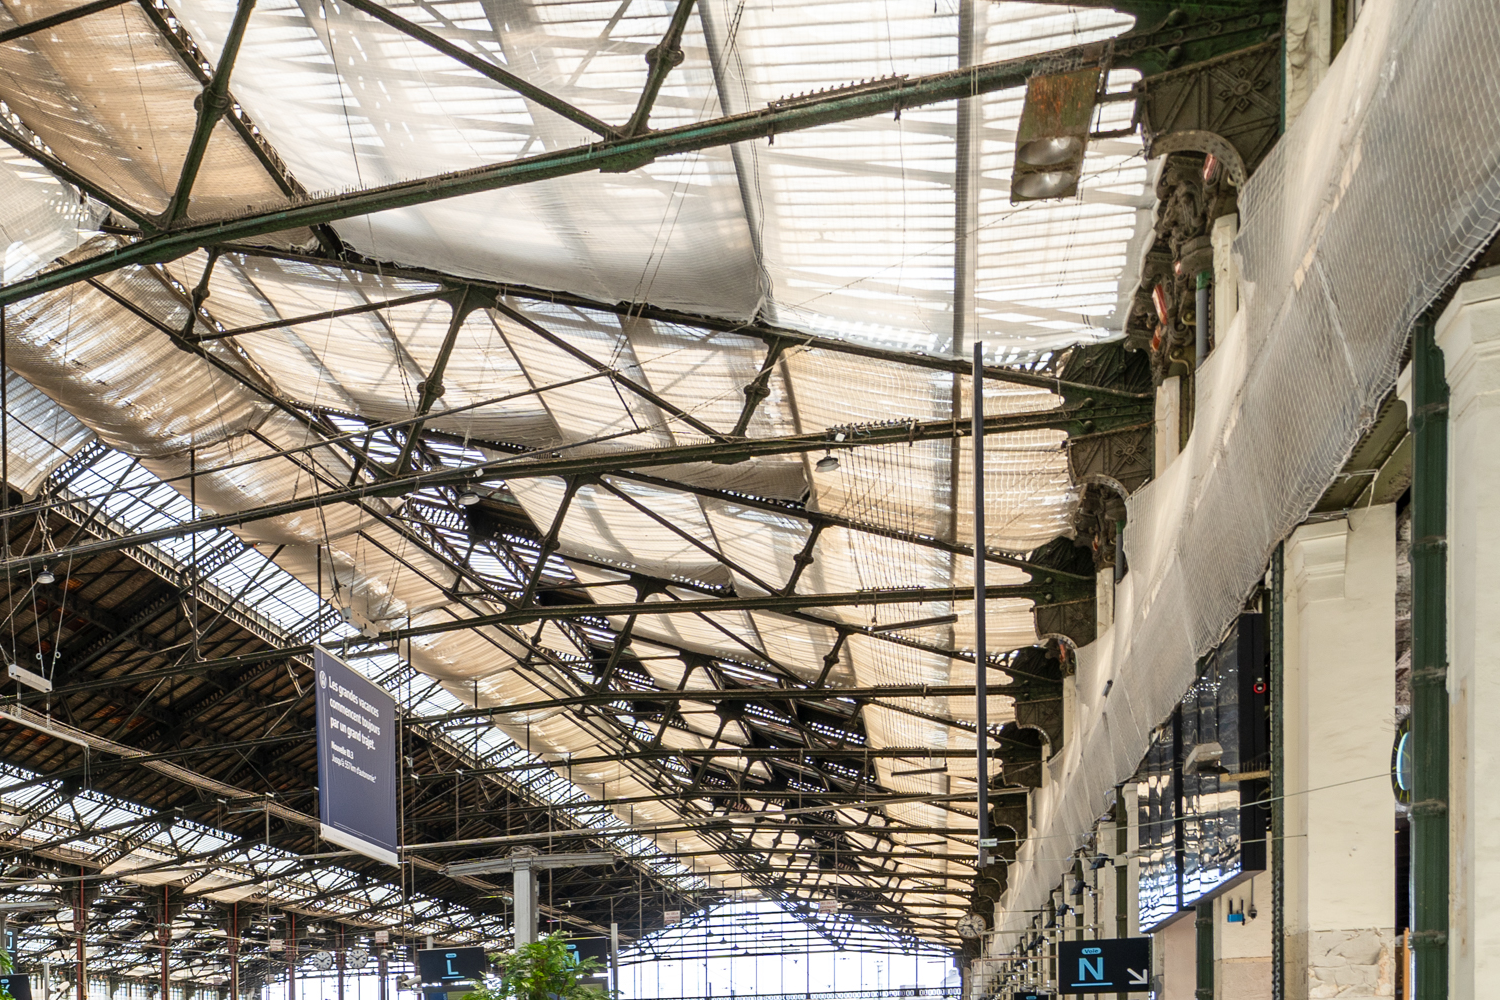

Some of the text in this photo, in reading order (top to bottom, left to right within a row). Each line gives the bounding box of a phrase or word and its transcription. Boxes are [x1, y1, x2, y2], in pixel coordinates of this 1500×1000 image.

[329, 676, 379, 718] Les grandes vacances
[330, 698, 380, 735] commencent toujours
[330, 717, 339, 729] par
[340, 722, 346, 733] un
[347, 727, 361, 741] grand
[447, 960, 459, 975] L
[1079, 957, 1104, 981] N
